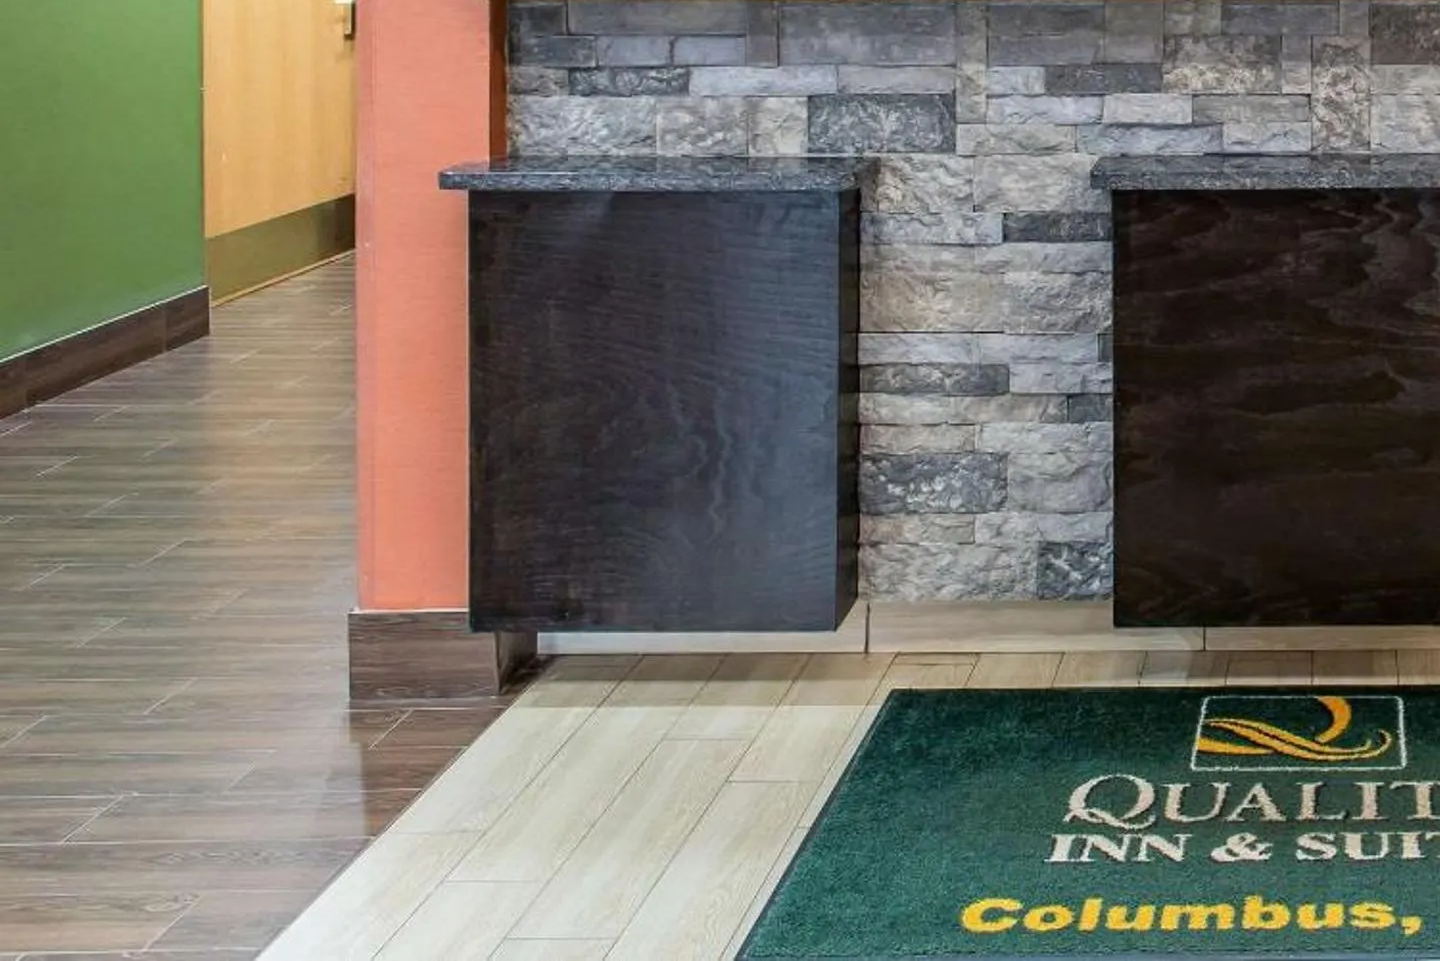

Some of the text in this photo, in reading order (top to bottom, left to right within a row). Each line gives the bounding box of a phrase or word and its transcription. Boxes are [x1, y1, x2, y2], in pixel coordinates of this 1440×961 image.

[1044, 833, 1193, 863] INN
[1210, 832, 1273, 863] &
[960, 895, 1422, 936] Columbus,
